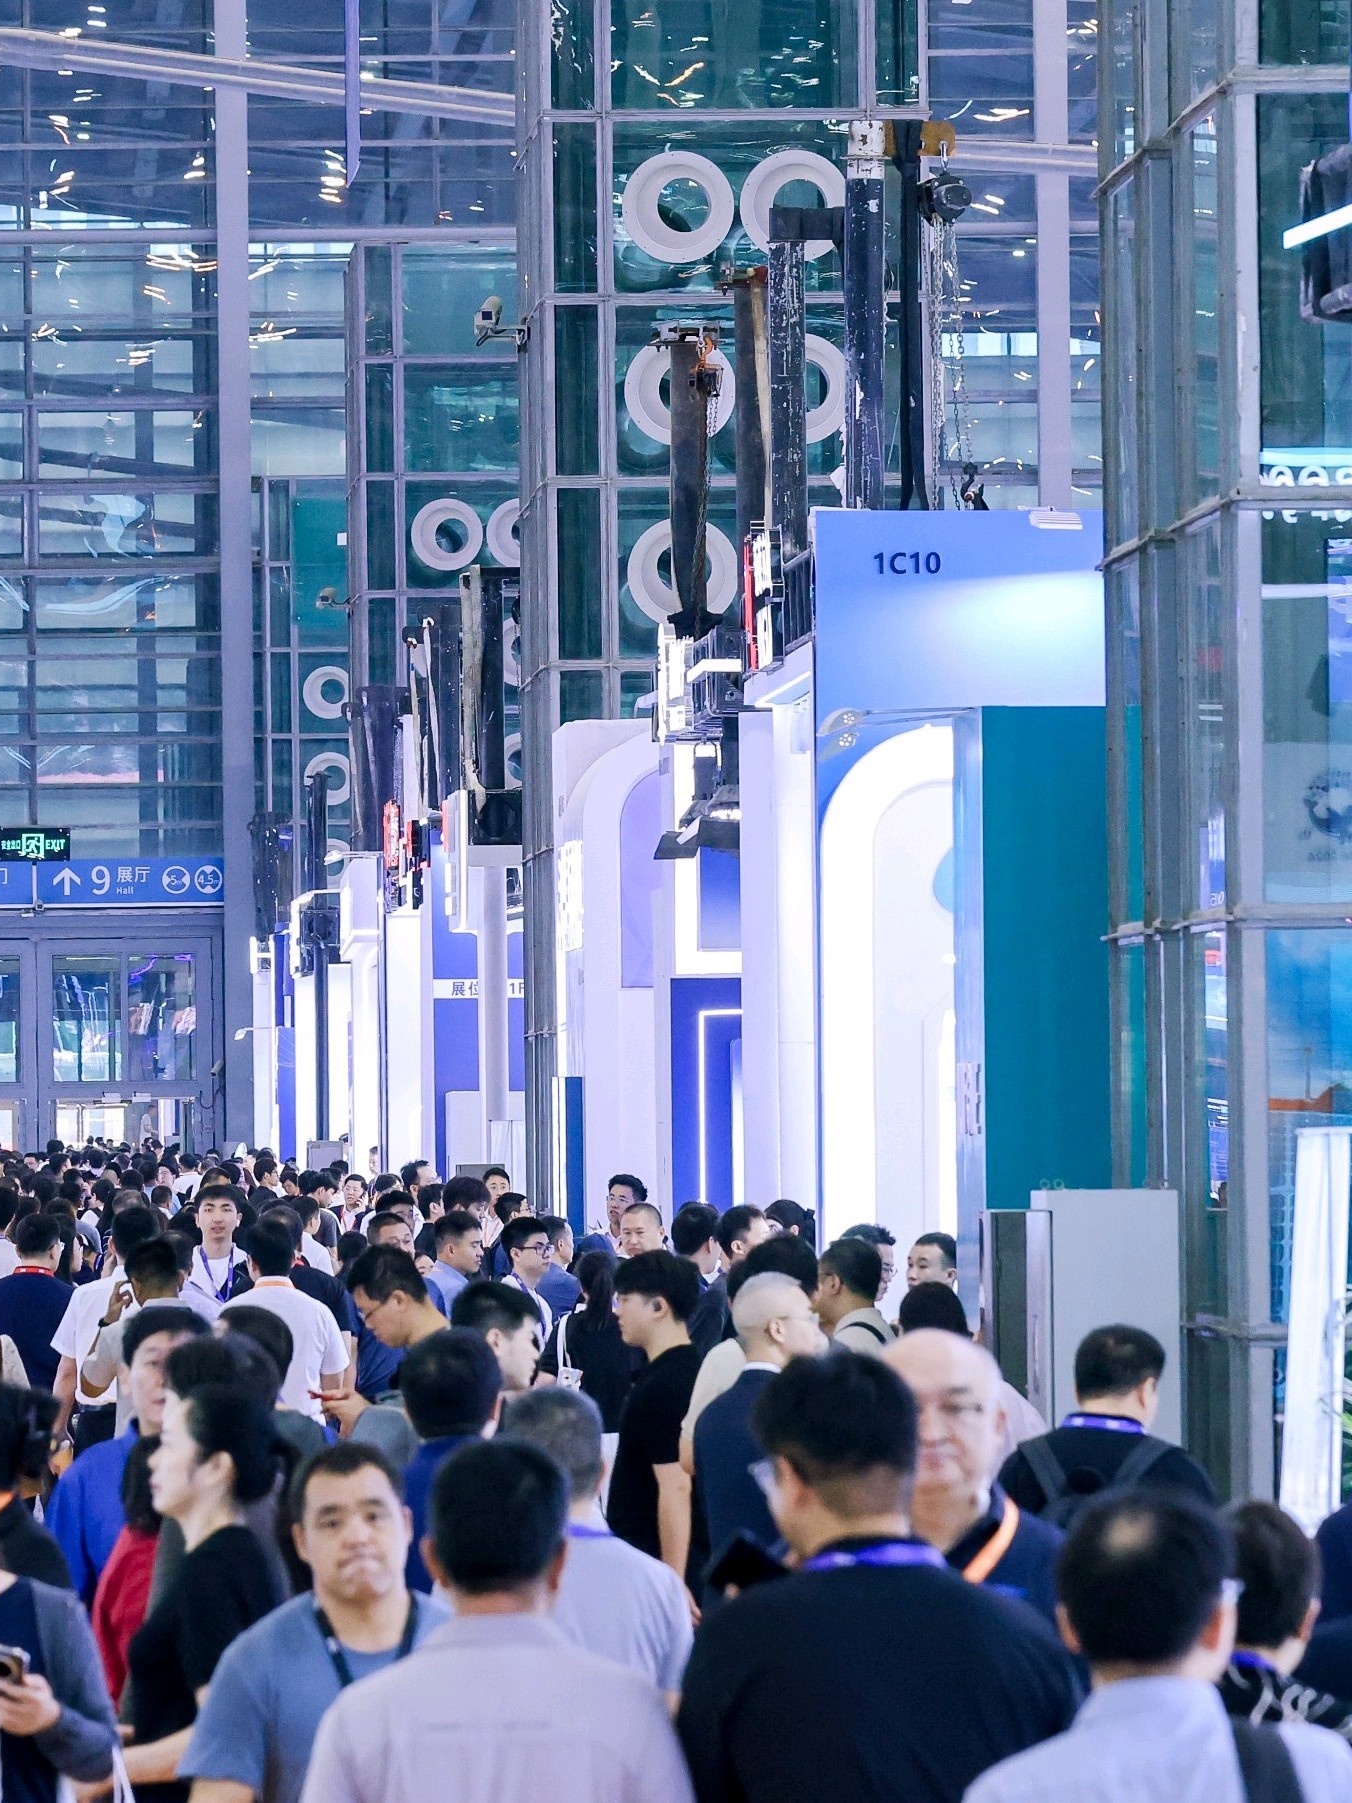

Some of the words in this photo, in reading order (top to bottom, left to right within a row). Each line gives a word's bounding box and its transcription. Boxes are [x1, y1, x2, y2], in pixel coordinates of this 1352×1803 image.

[873, 552, 942, 574] 1C10
[45, 839, 66, 850] EXIT
[91, 865, 111, 895] 9
[116, 866, 151, 883] 展厅
[116, 887, 134, 895] Hall
